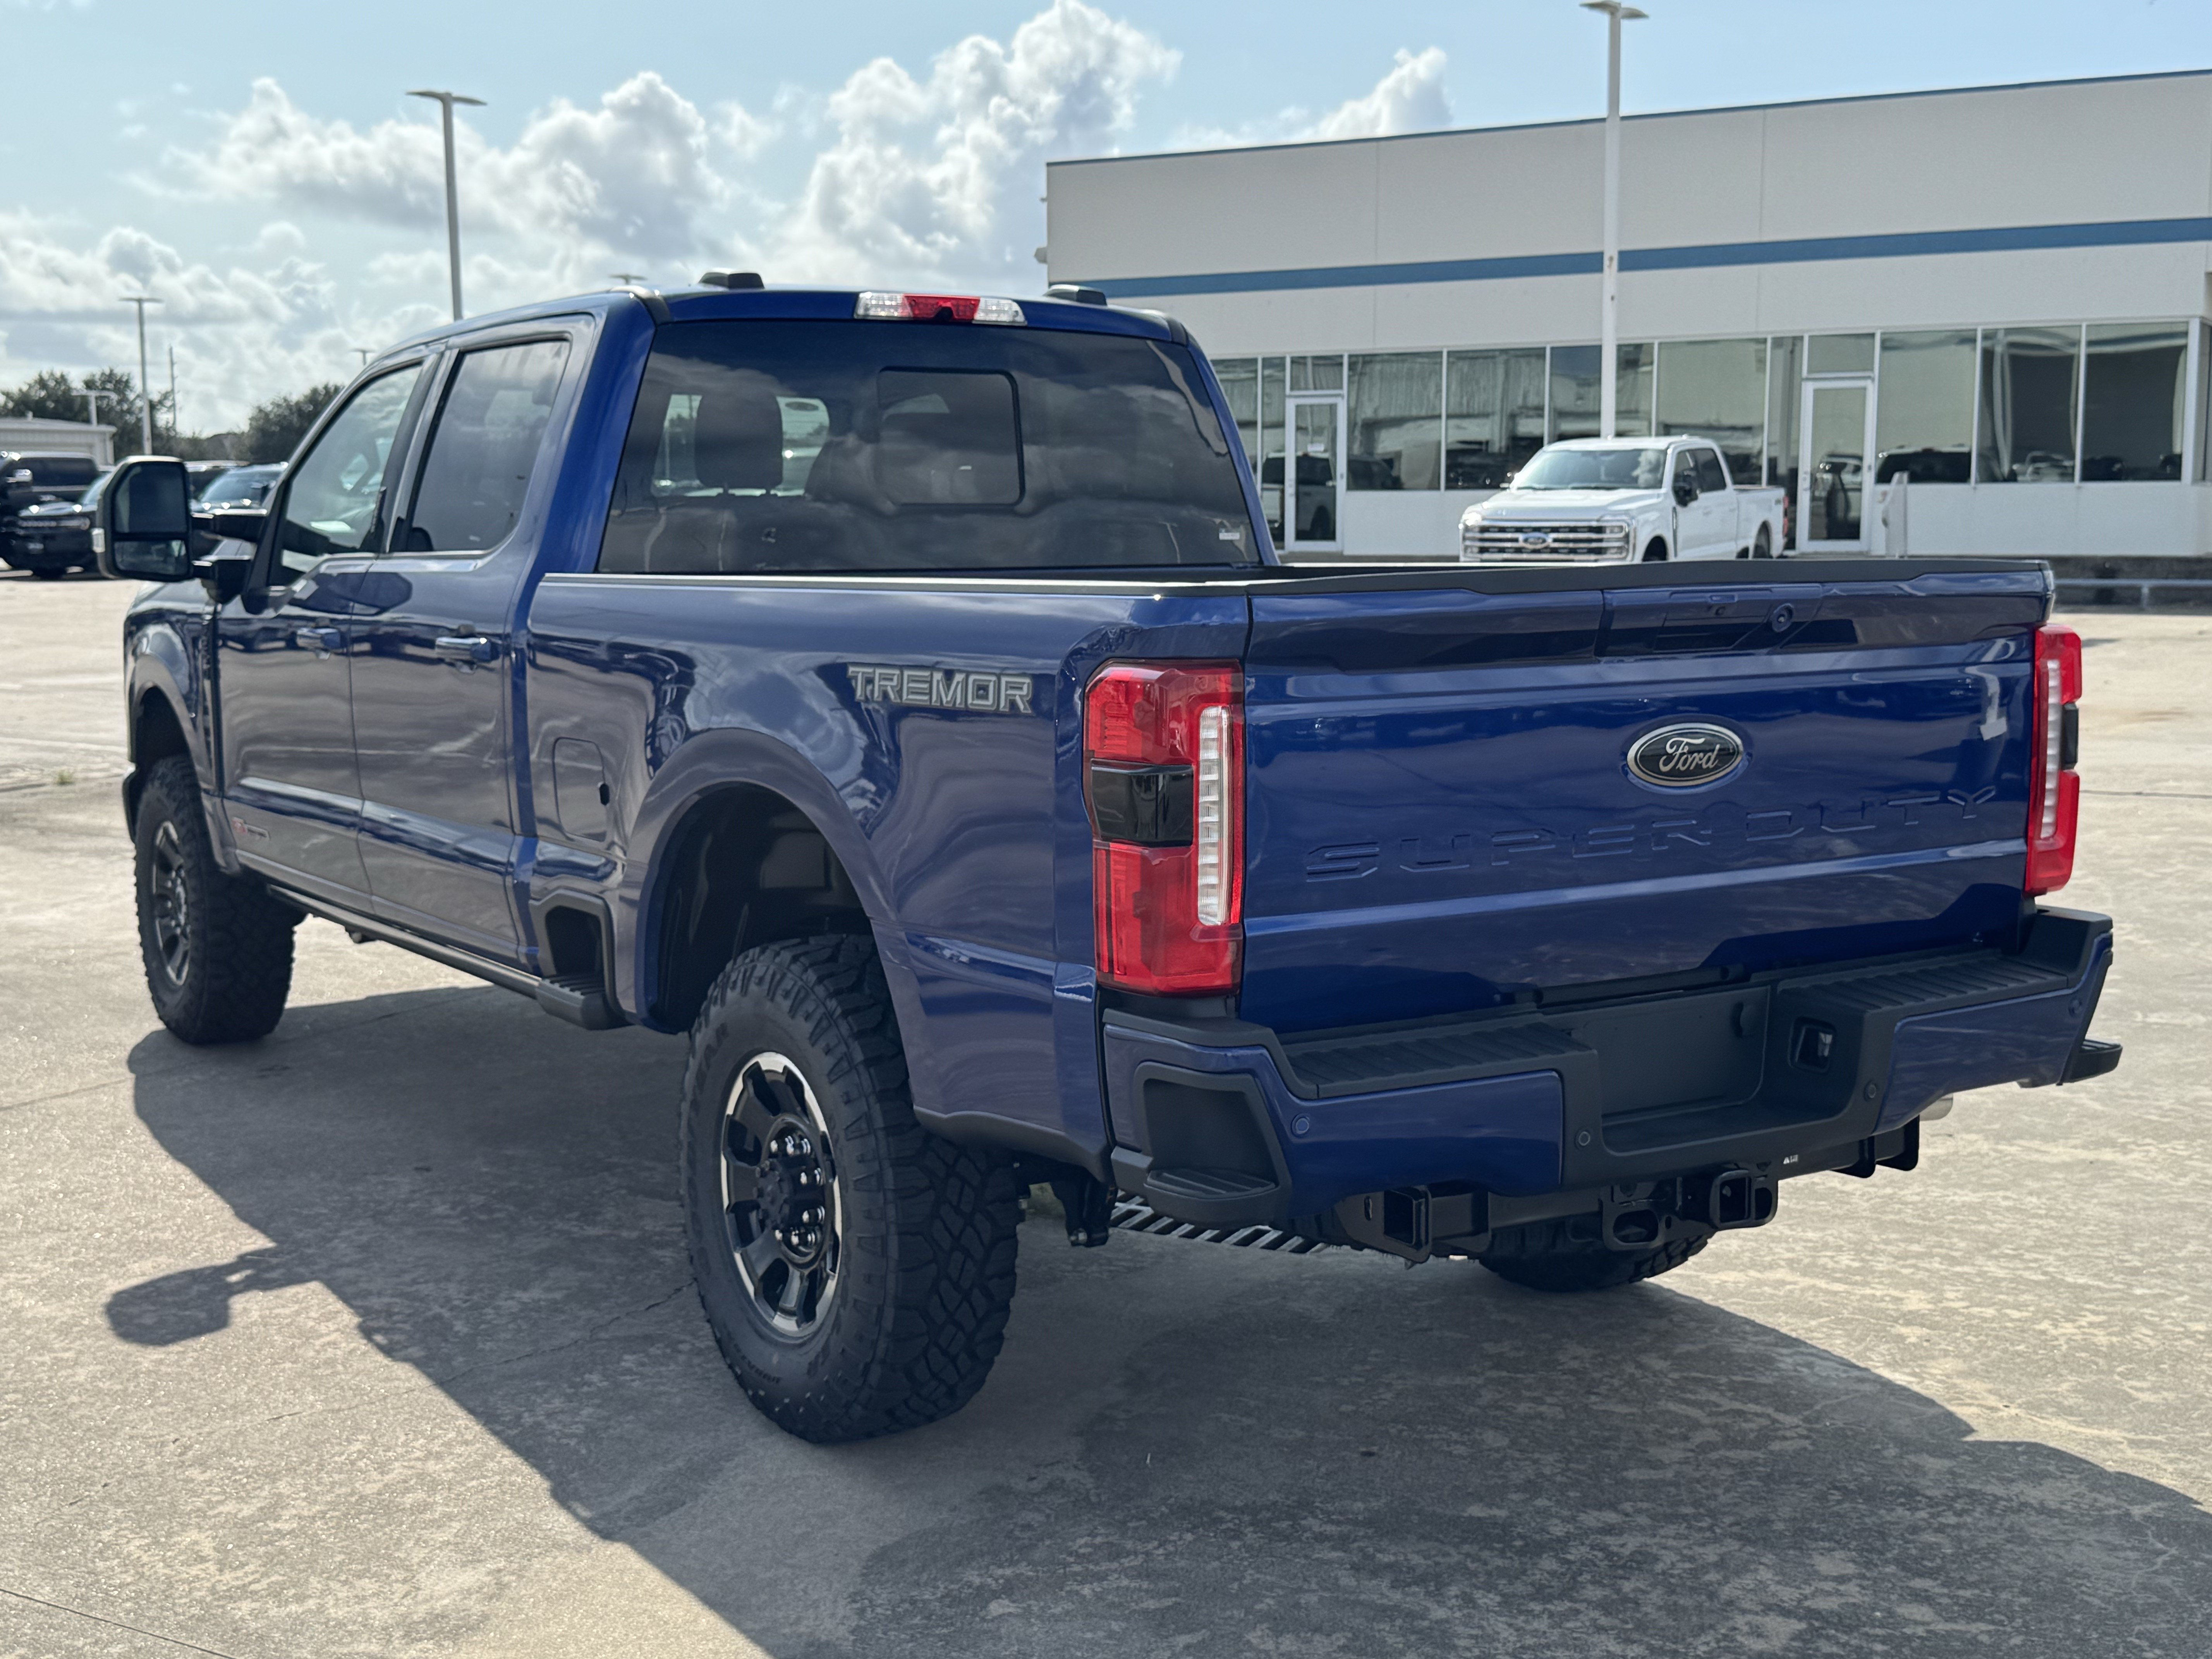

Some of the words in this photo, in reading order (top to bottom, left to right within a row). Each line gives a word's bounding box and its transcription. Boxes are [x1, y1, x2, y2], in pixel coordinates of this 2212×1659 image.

[847, 663, 1034, 715] TREMOR
[1659, 737, 1720, 772] Ford
[1305, 816, 1712, 882] SUPER
[1745, 785, 1996, 842] DUTY
